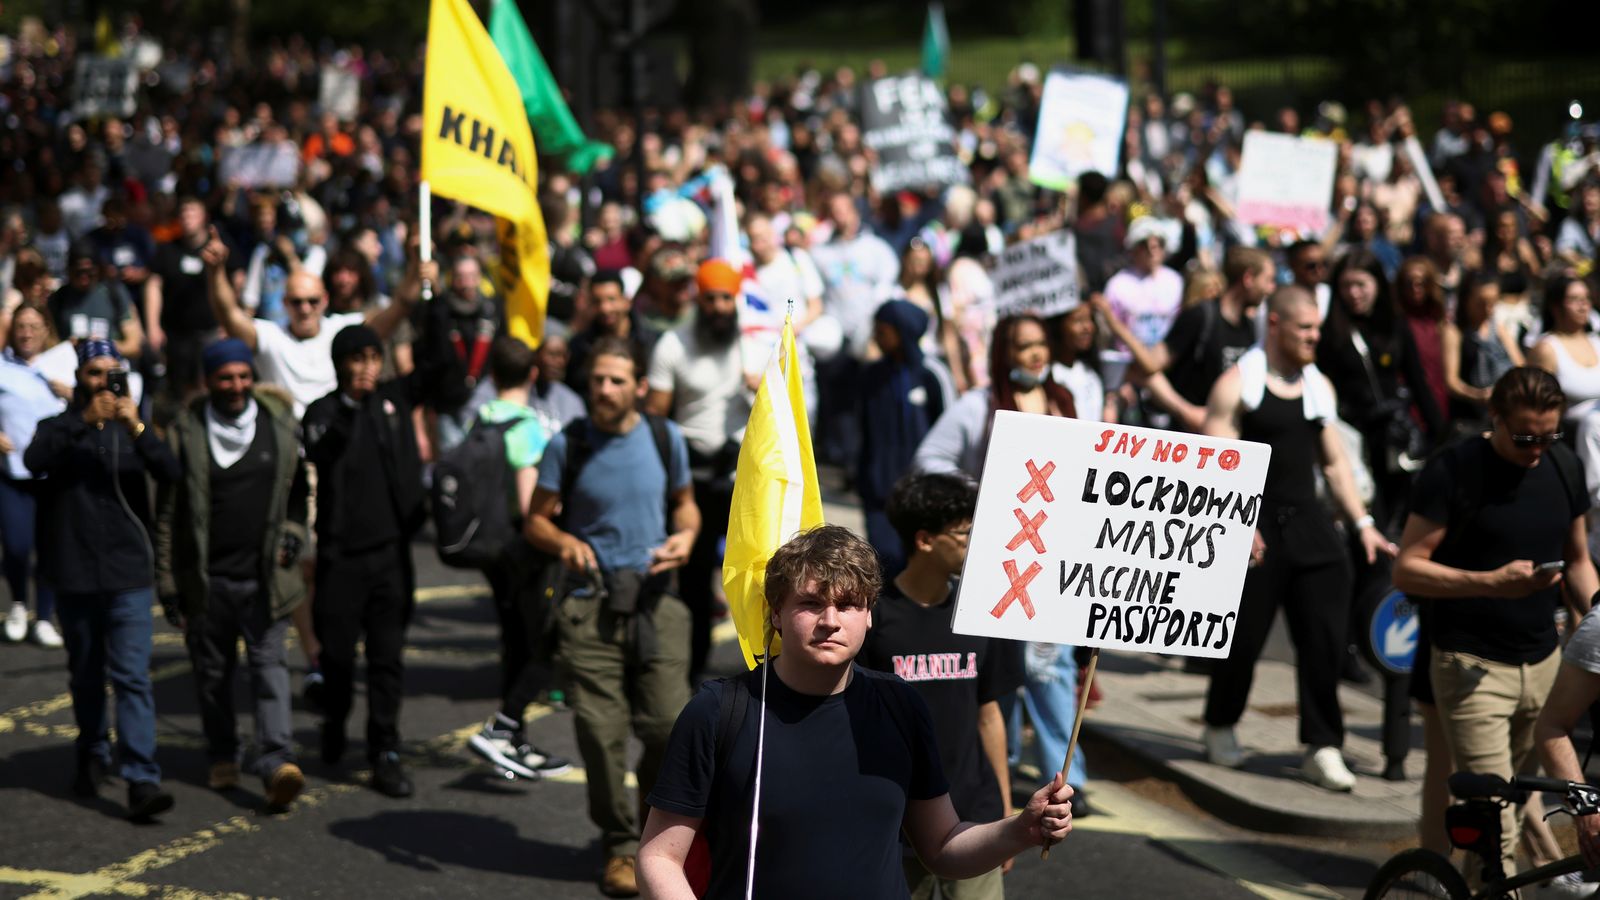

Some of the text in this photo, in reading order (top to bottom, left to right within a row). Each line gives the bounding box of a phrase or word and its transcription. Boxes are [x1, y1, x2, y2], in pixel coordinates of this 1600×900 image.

[439, 105, 527, 182] KHA
[1095, 429, 1241, 471] SAY NO TO
[1081, 468, 1262, 527] LOCKDOWNS
[1094, 518, 1226, 568] MASKS
[1059, 560, 1180, 604] VACCINE
[1086, 603, 1236, 649] PASSPORTS
[892, 652, 978, 682] MANILA
